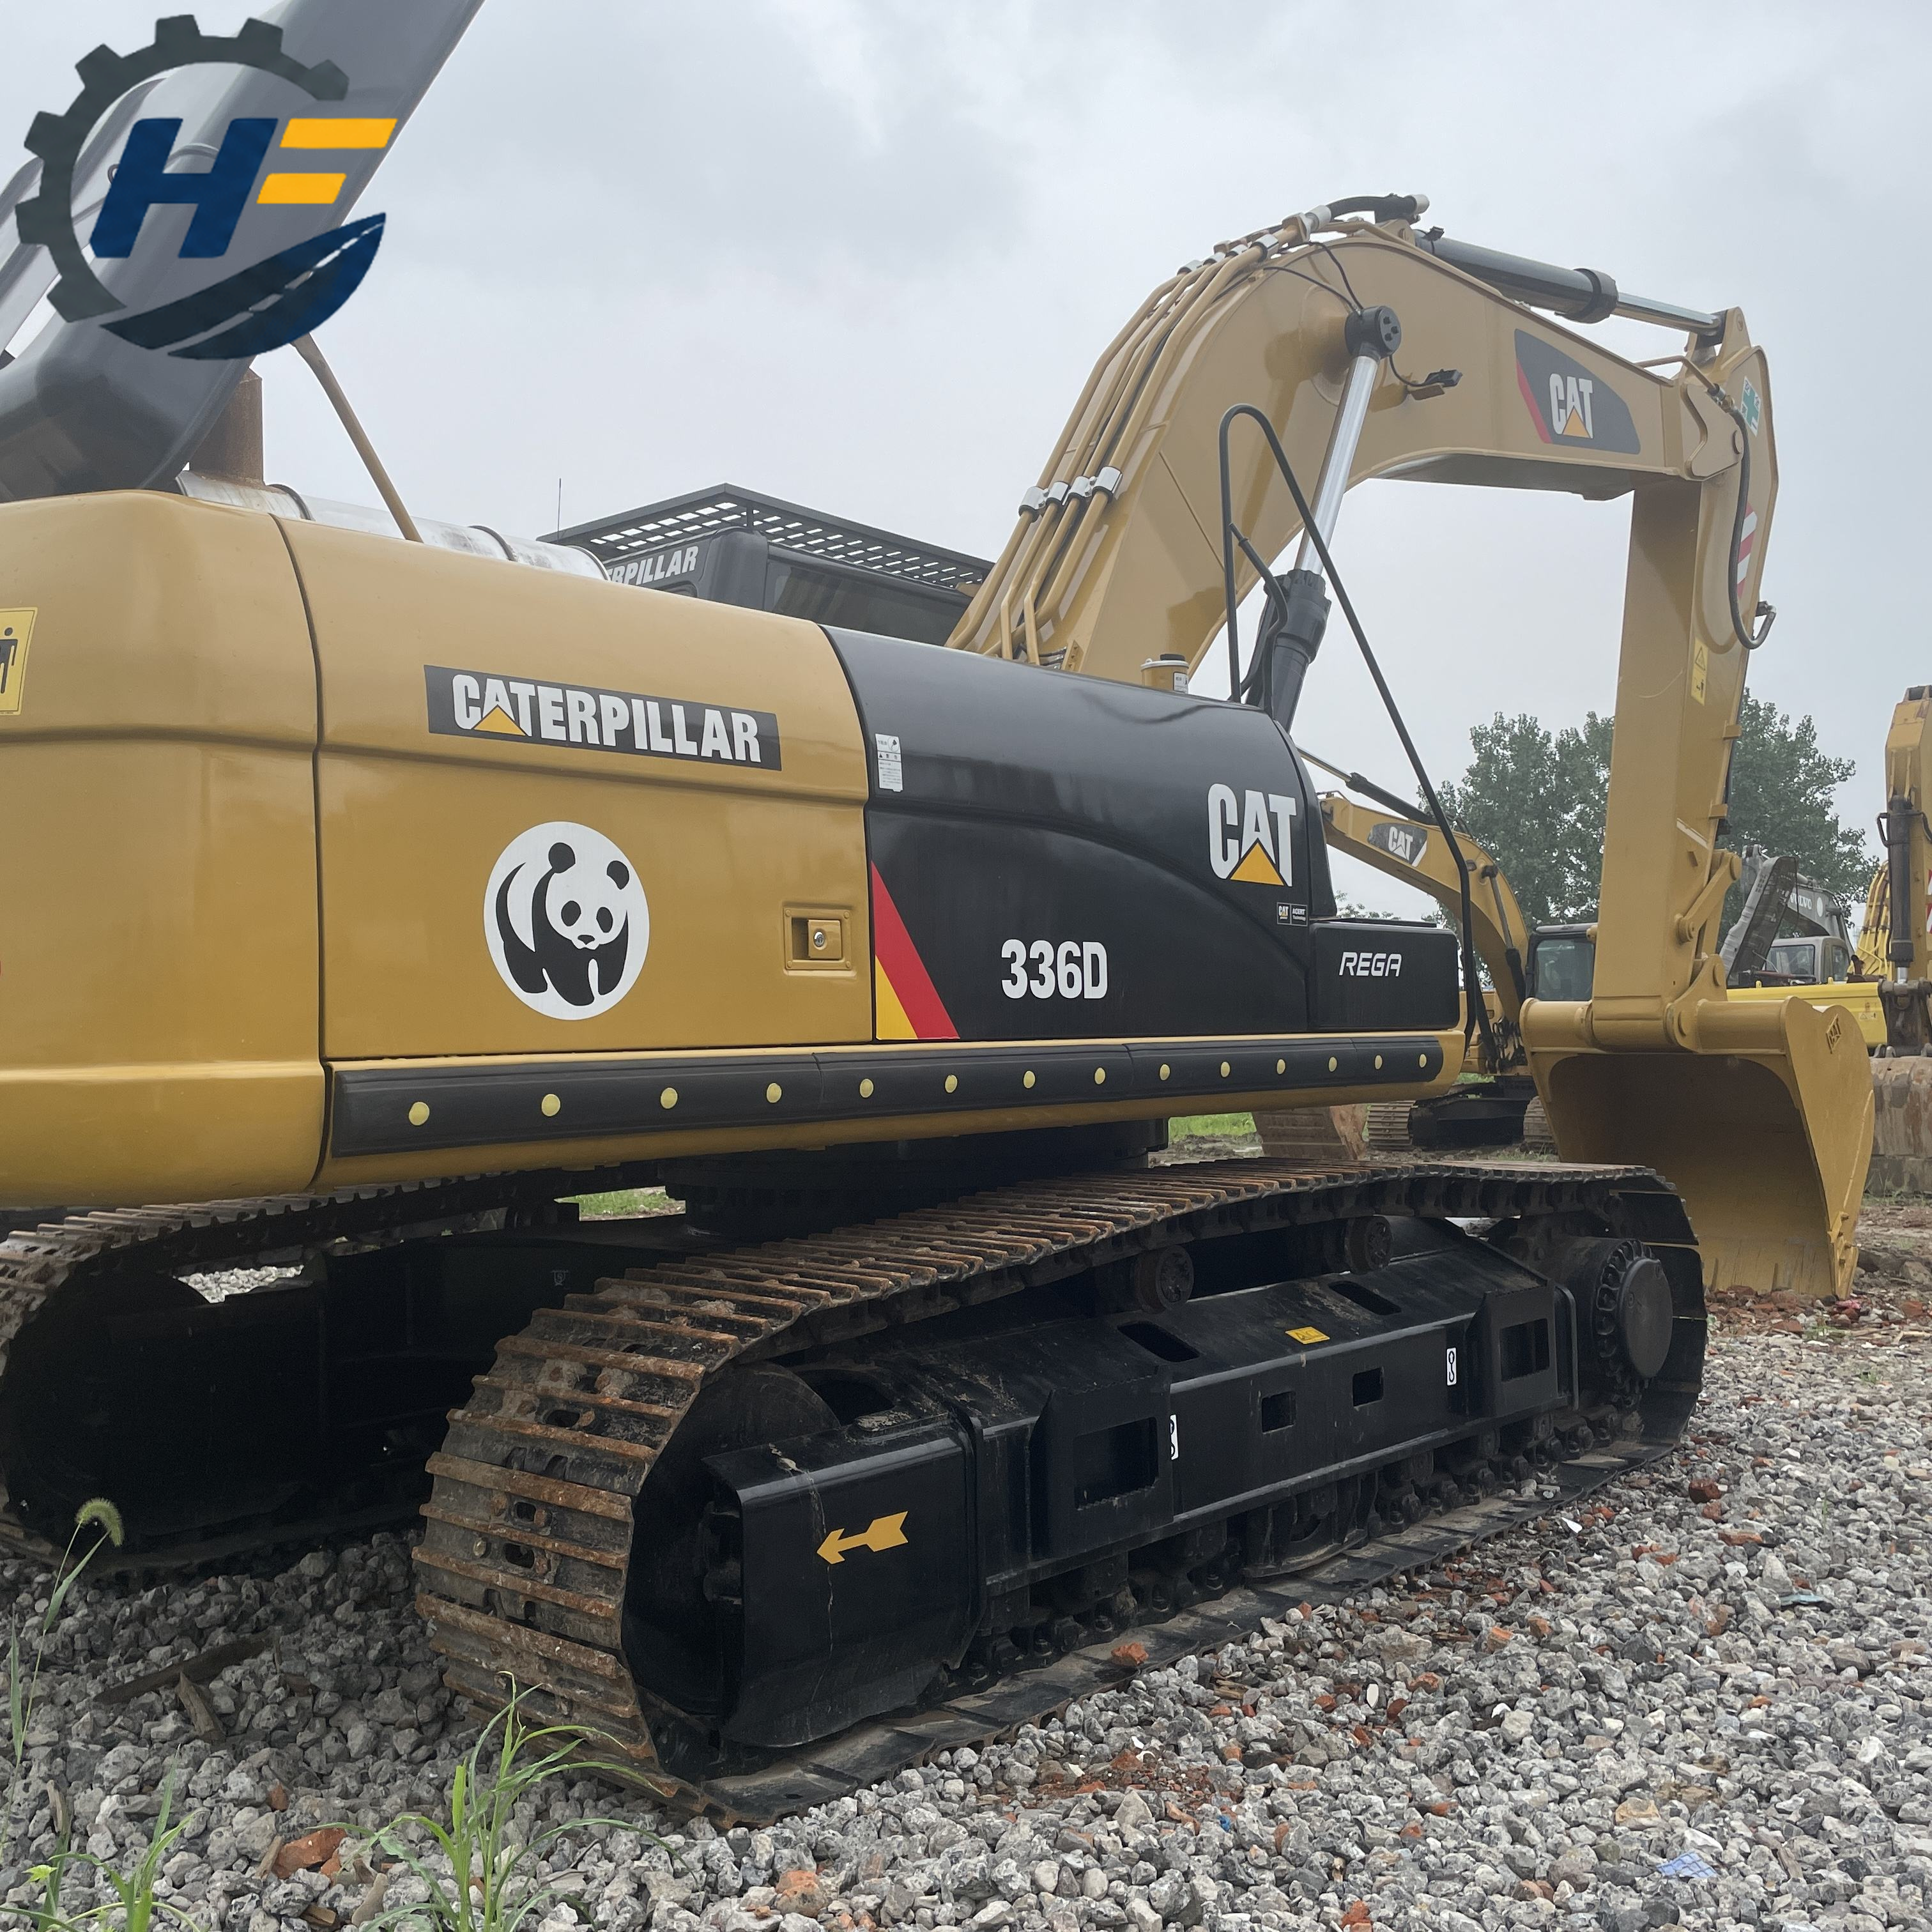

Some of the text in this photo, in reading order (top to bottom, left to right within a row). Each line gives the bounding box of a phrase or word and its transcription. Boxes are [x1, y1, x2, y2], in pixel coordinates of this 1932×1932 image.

[1549, 373, 1593, 439] CAT
[452, 674, 762, 763] CATERPILLAR
[1208, 783, 1297, 887] CAT
[1388, 826, 1413, 861] CAT
[1278, 905, 1289, 916] CAT
[1001, 939, 1108, 999] 336D
[1338, 951, 1402, 977] REGA
